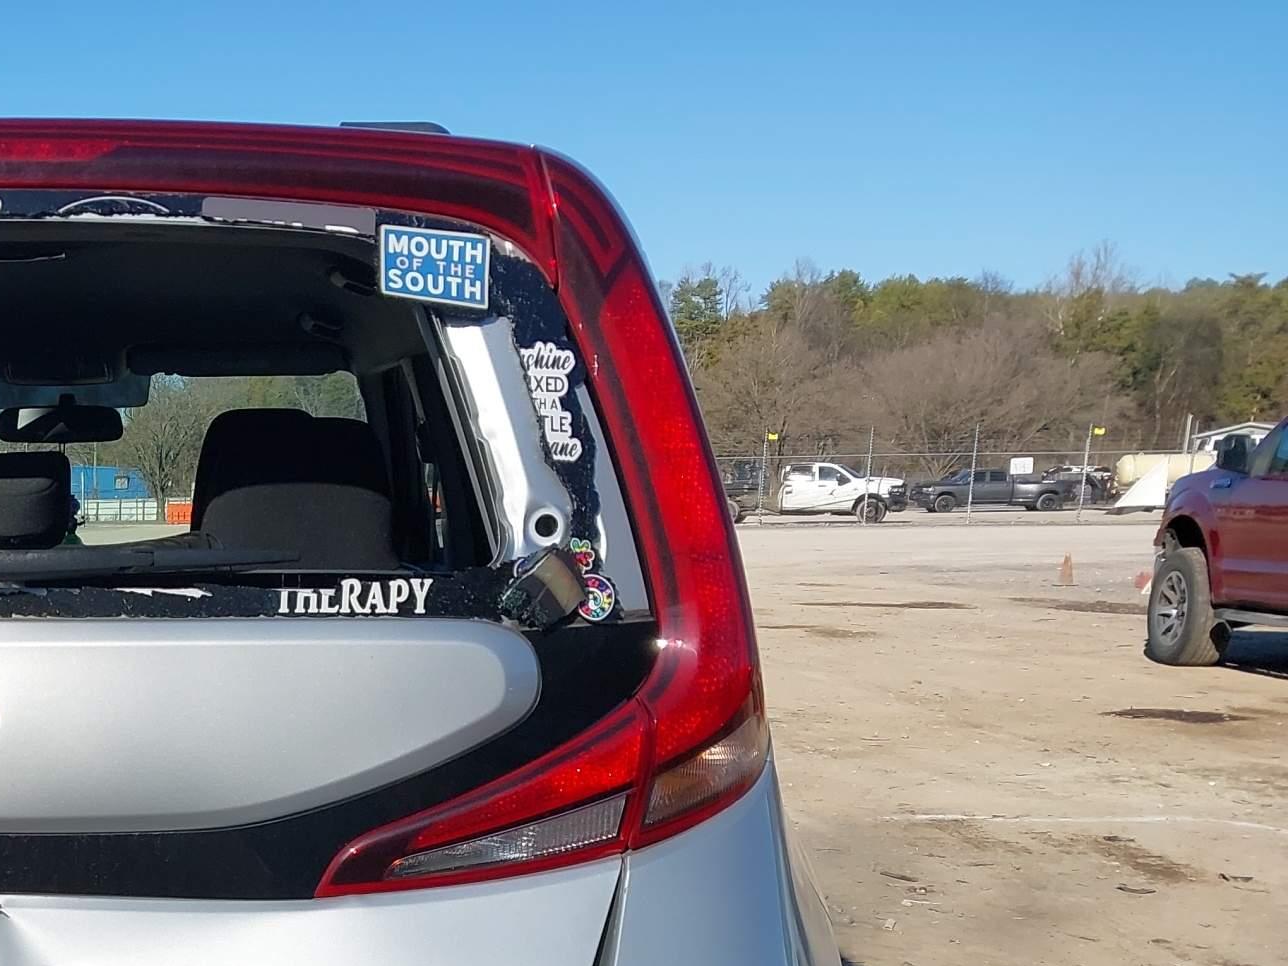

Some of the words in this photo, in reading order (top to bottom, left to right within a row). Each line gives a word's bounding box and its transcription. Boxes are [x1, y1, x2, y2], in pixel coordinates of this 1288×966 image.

[387, 233, 483, 264] MOUTH
[396, 256, 423, 271] OF
[436, 260, 475, 278] THE
[387, 268, 481, 301] SOUTH
